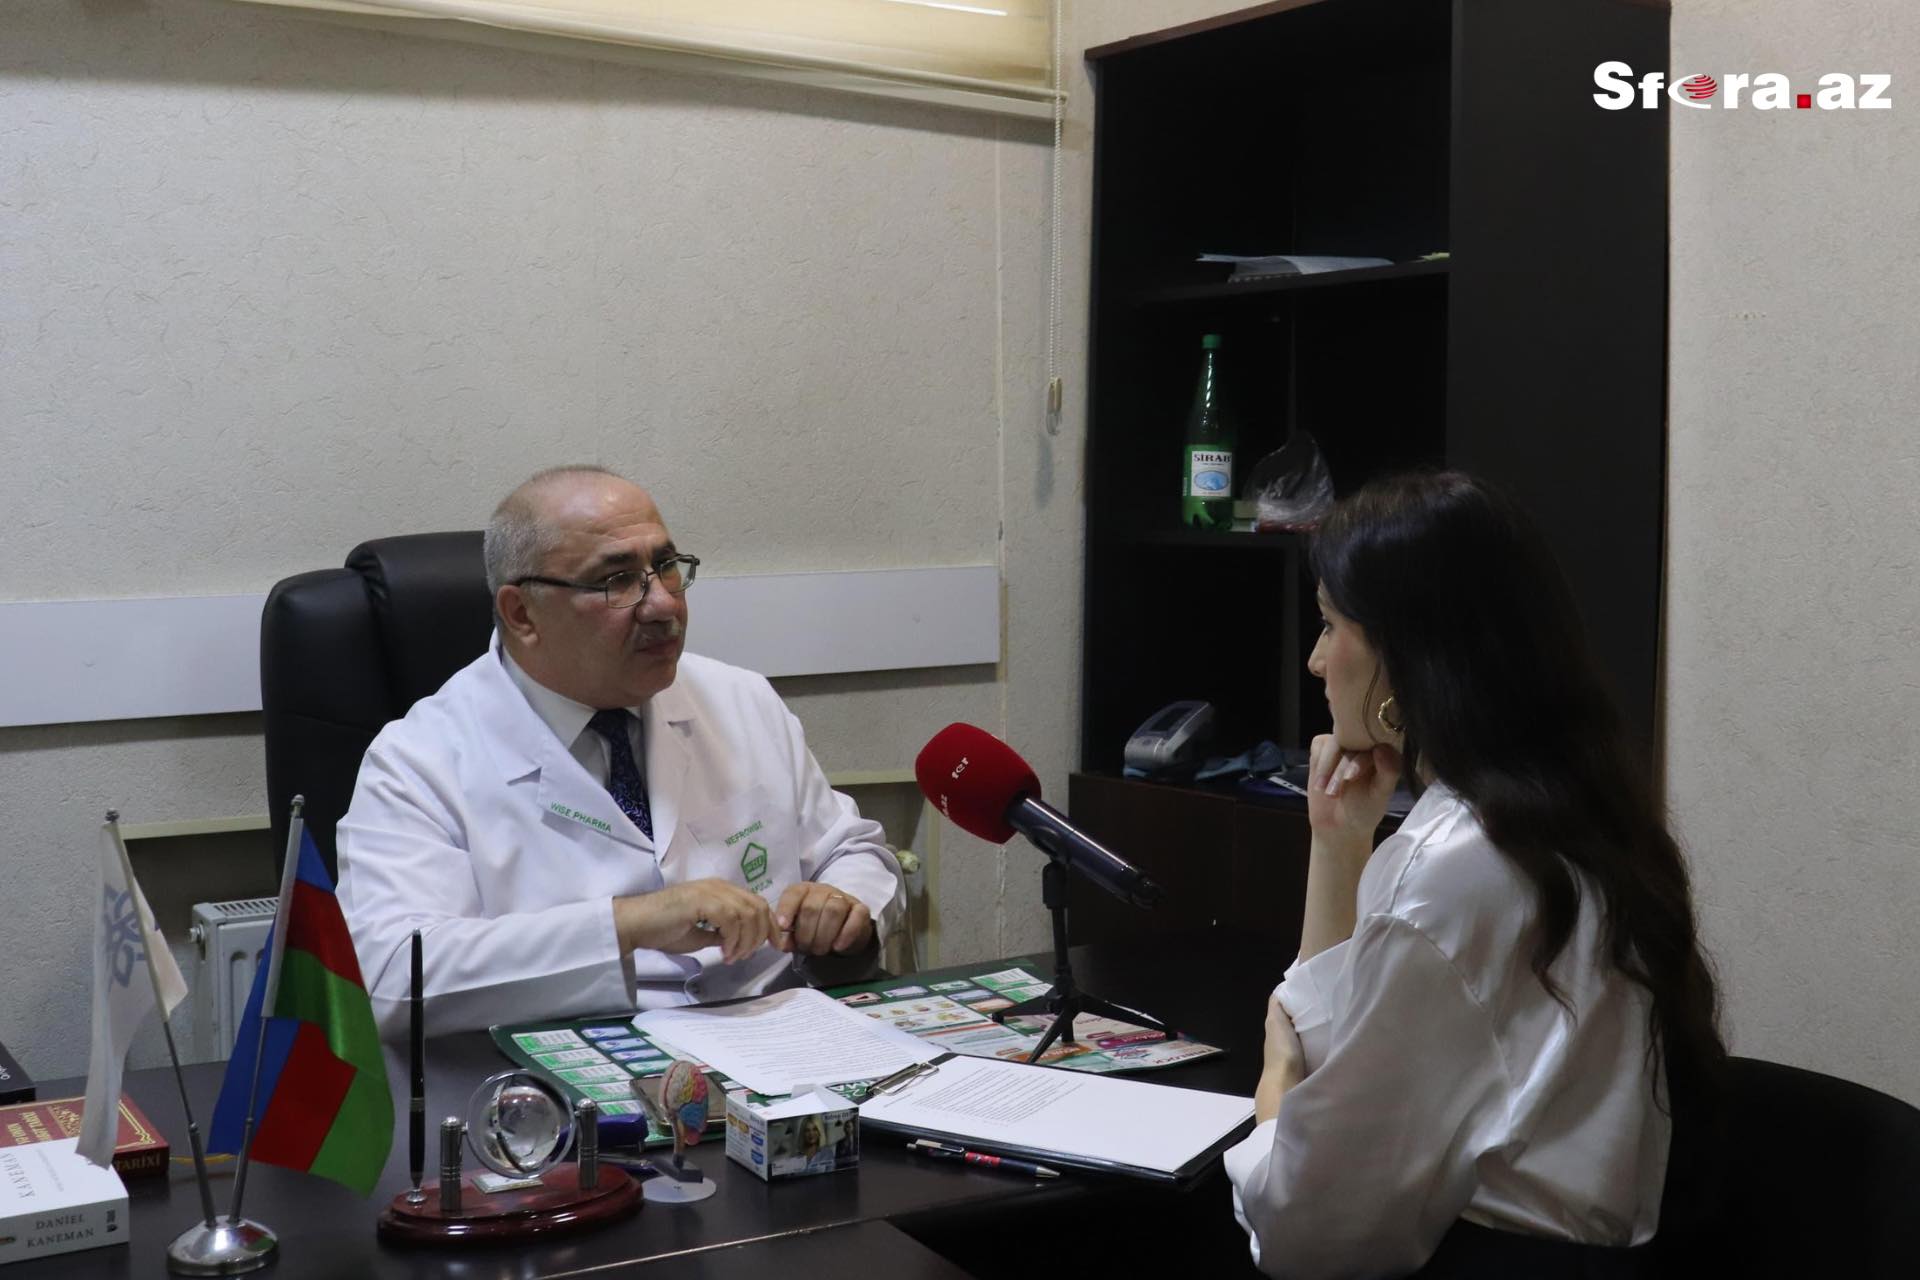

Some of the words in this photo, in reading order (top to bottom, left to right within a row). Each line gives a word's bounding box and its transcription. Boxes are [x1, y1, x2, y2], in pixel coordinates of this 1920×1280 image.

[550, 801, 572, 817] WISE
[573, 811, 612, 833] PHARMA
[27, 1228, 94, 1248] KANEMAN
